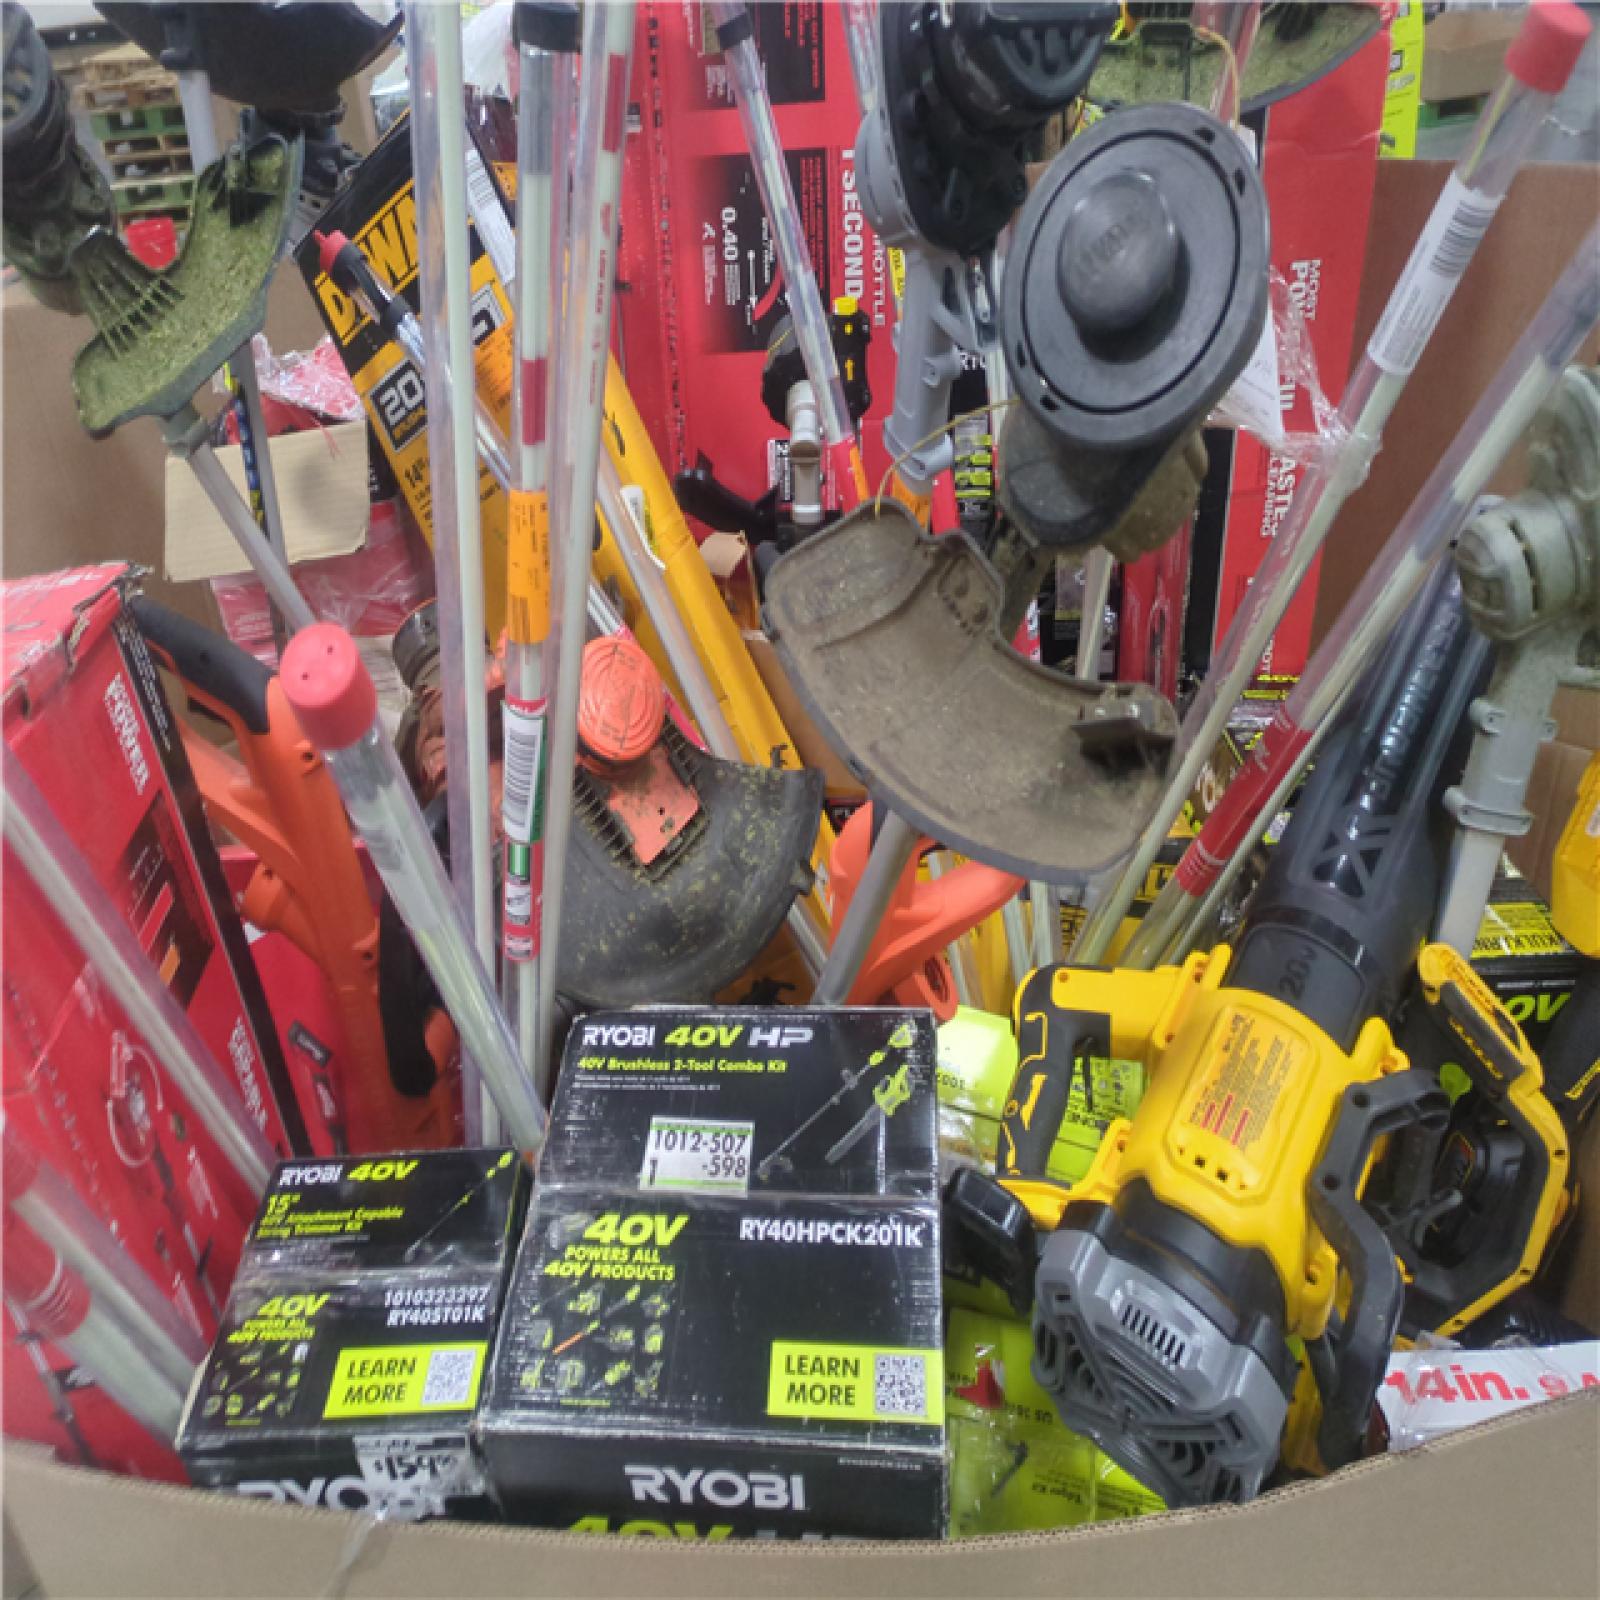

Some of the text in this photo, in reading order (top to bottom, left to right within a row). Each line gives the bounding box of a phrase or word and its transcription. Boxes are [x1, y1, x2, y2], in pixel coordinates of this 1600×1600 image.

[720, 207, 738, 261] 0.40
[582, 1024, 815, 1049] RYOBI 40V HP
[577, 1056, 605, 1071] 40V
[607, 1057, 670, 1072] Brushless
[717, 1059, 764, 1073] Combo
[767, 1060, 788, 1073] Kit
[653, 1131, 748, 1154] 1012-507
[279, 1160, 420, 1186] RYOBI 40V
[702, 1154, 747, 1178] -598
[583, 1211, 690, 1246] 40V
[739, 1216, 923, 1248] RY40HPCK201K
[565, 1244, 661, 1264] POWERS ALL
[544, 1260, 676, 1281] 40V PRODUCTS
[257, 1292, 332, 1317] 40V
[346, 1356, 417, 1380] LEARN
[785, 1354, 861, 1378] LEARN
[342, 1382, 408, 1406] MORE
[785, 1381, 856, 1406] MORE
[1384, 1364, 1530, 1407] 14in.
[623, 1463, 808, 1512] RYOBI
